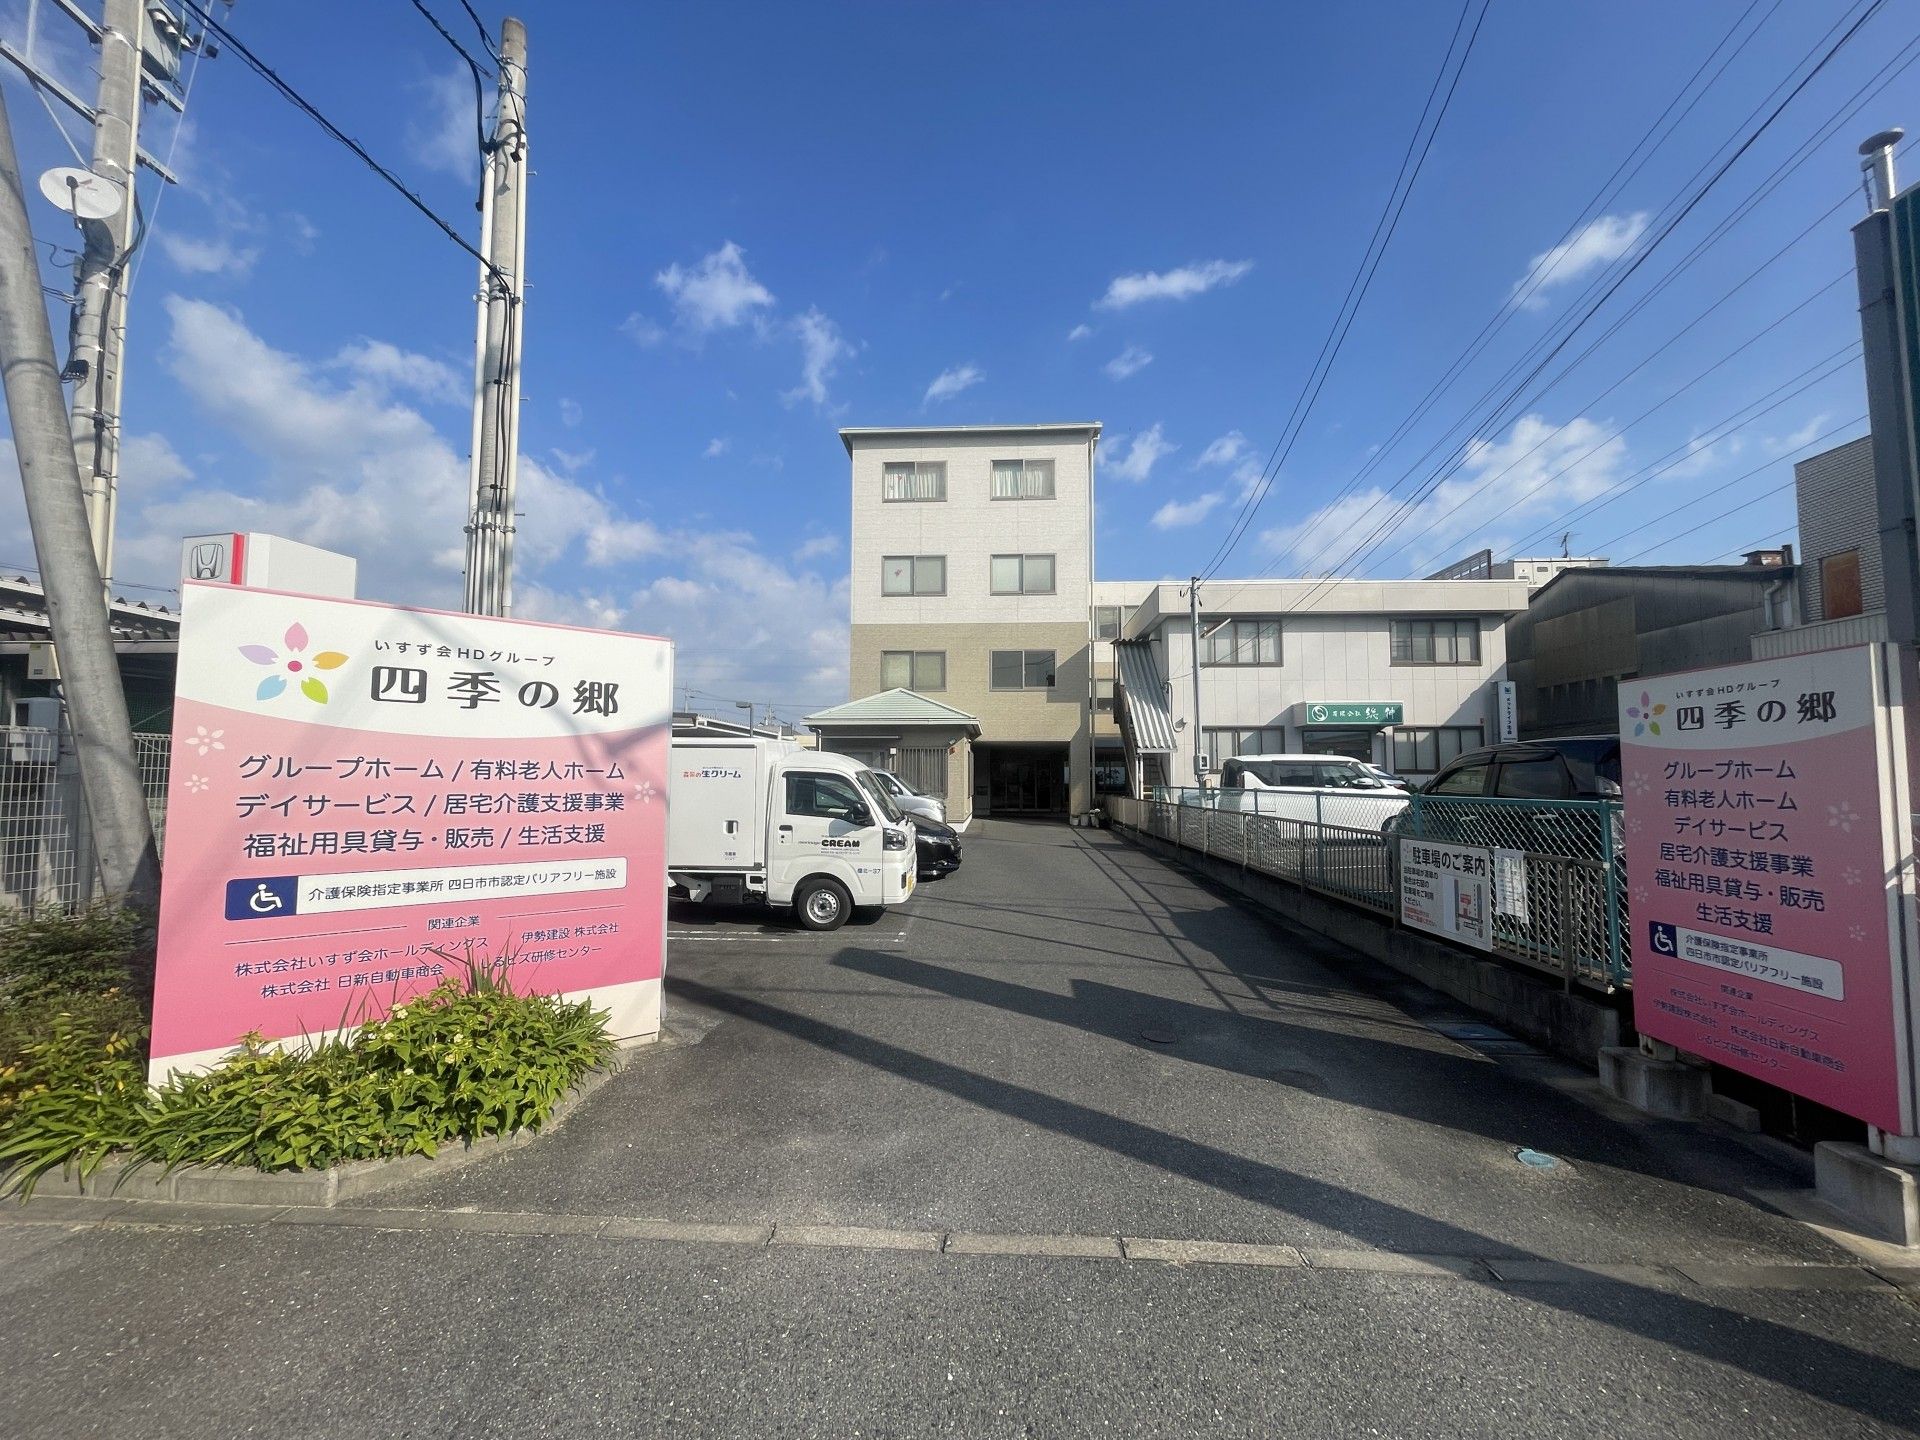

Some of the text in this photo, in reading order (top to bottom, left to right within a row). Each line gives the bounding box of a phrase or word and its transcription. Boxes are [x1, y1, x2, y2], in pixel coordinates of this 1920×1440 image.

[374, 639, 557, 667] いすず会HDグループ
[369, 665, 620, 718] 四季の郷
[1675, 678, 1781, 700] いすず会HDグループ
[1676, 690, 1837, 731] 四季の郷
[1663, 760, 1796, 781] グループホーム
[1664, 788, 1798, 811] 有料老人ホーム
[1674, 817, 1788, 842] デイサービス
[821, 839, 860, 848] CREAM
[1412, 846, 1486, 877] 駐車場のご案内
[1660, 843, 1815, 878] 居宅介護支援事業
[308, 868, 617, 902] 介護保険指定事業所 四日市市認定バリアフリー施設
[1655, 869, 1825, 912] 福祉用具貸与・販売
[427, 915, 480, 931] 関連企業
[1696, 902, 1774, 935] 生活支援
[521, 922, 619, 943] 伊勢建設 株式会社
[260, 978, 331, 999] 株式会社
